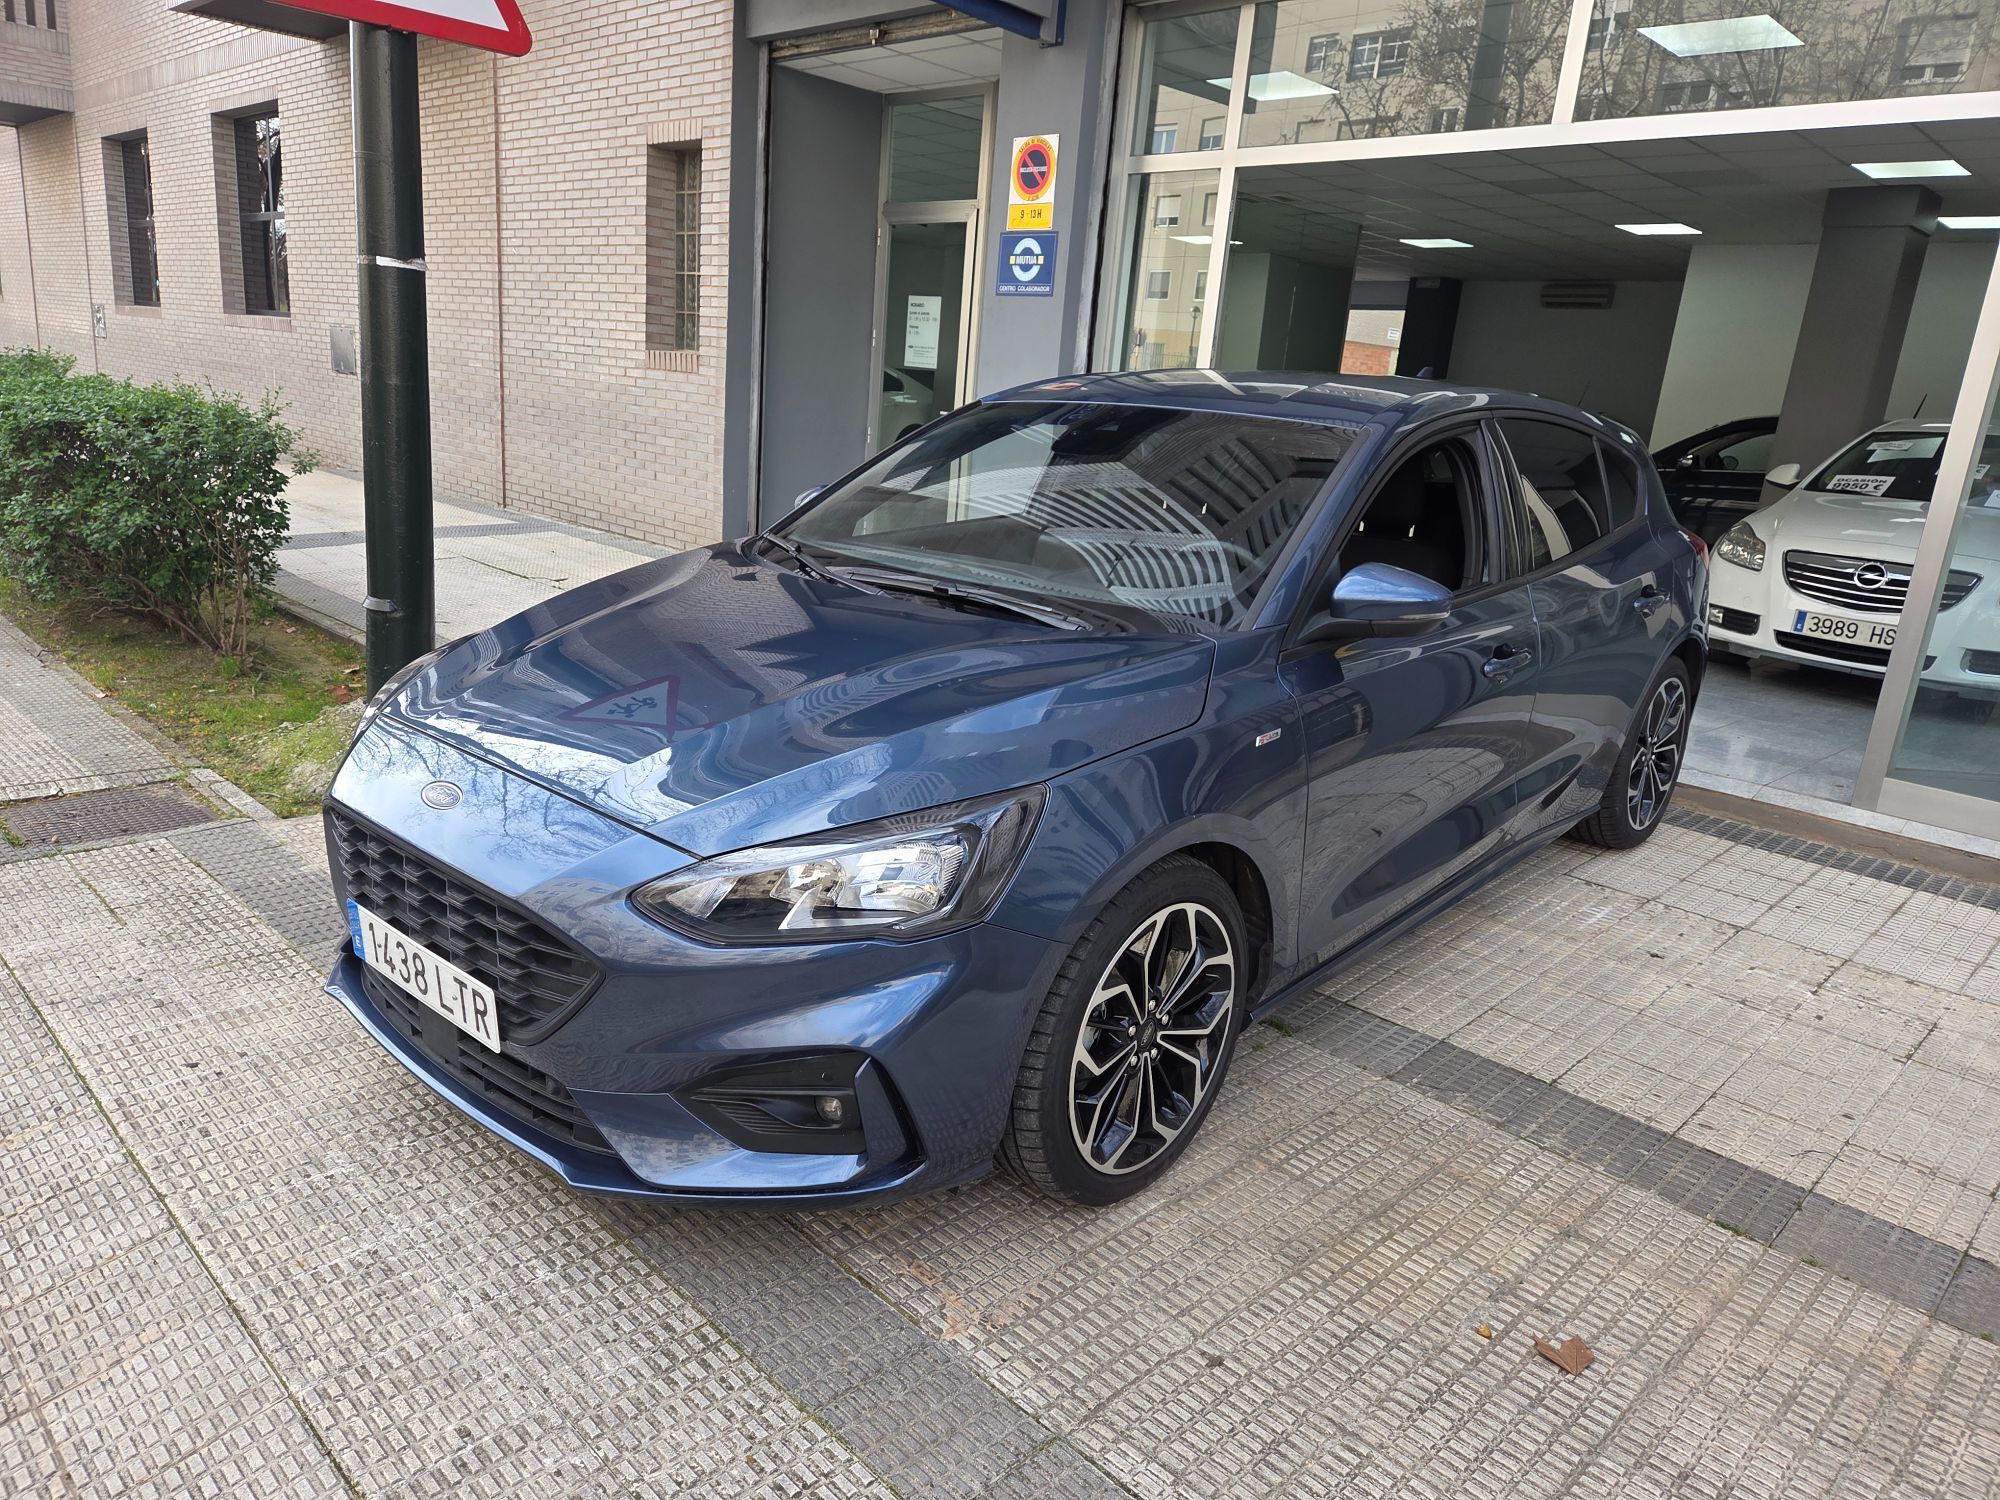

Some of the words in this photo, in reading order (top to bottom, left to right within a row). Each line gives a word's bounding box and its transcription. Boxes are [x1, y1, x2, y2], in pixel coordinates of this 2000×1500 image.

[1020, 209, 1025, 219] 9
[1015, 255, 1037, 265] MUTUA
[1808, 615, 1859, 640] 3989
[1868, 625, 1897, 646] HS
[354, 934, 361, 949] E
[368, 921, 429, 997] 1438
[434, 963, 492, 1041] LTR
